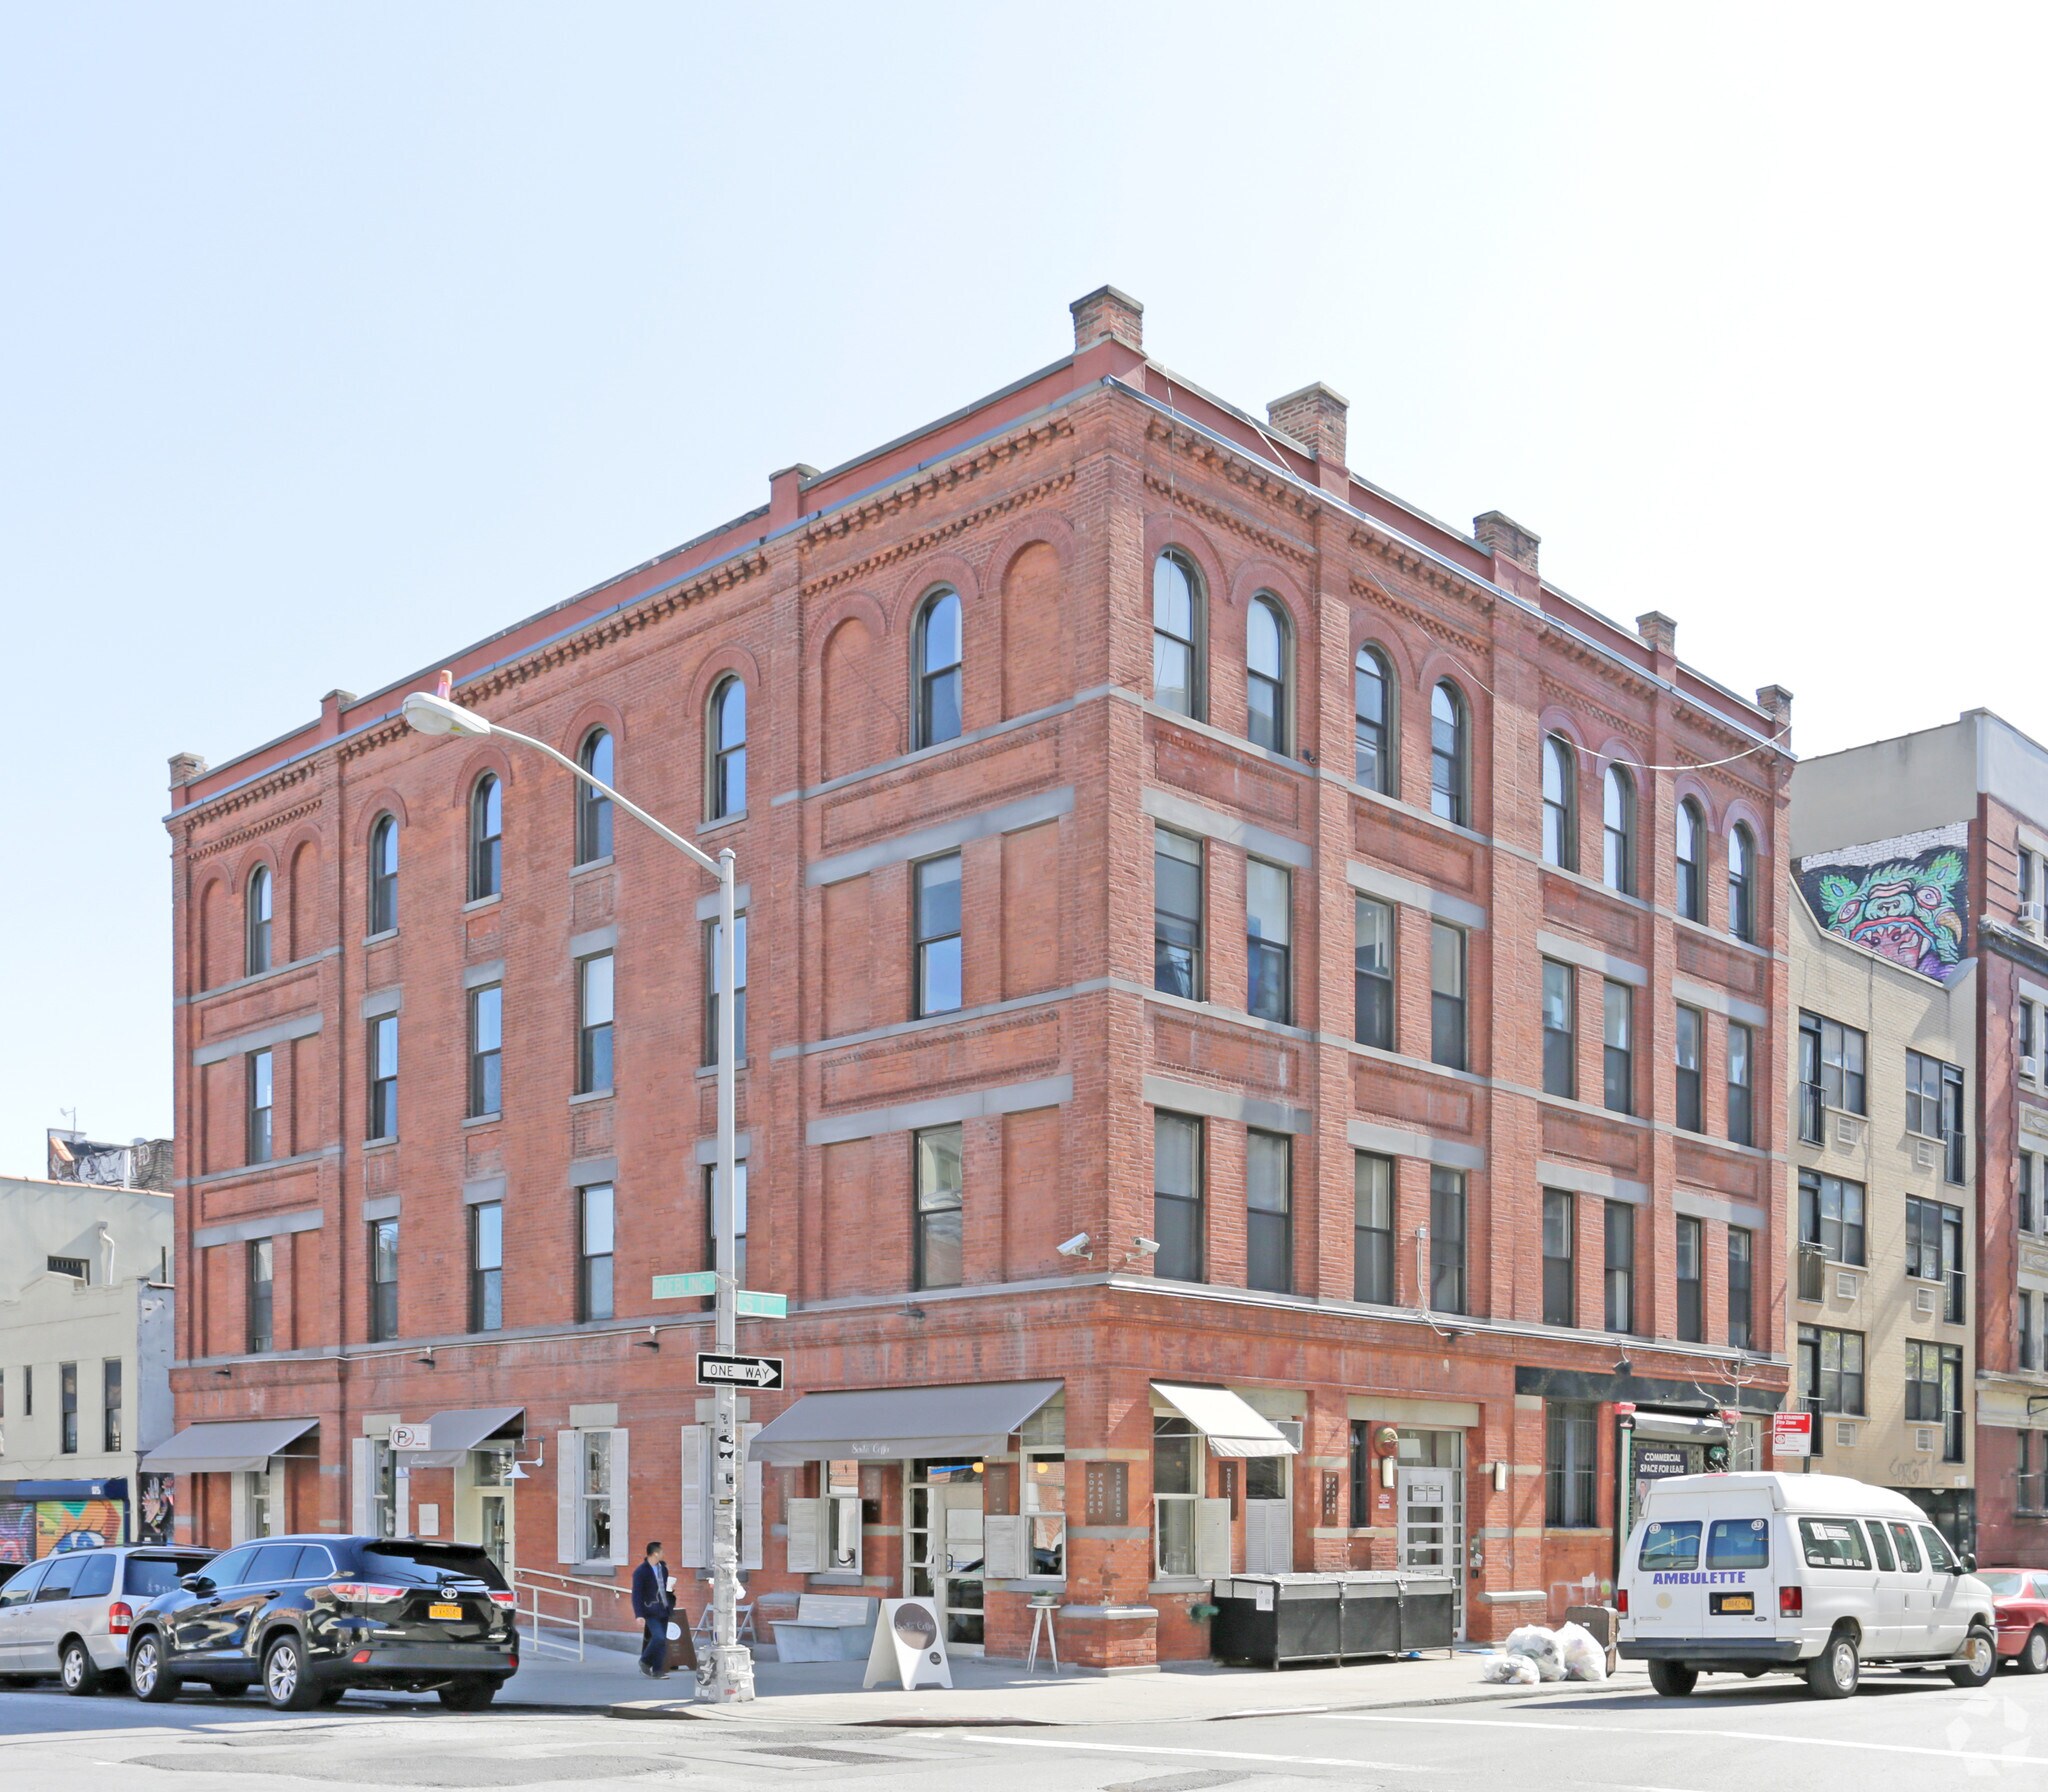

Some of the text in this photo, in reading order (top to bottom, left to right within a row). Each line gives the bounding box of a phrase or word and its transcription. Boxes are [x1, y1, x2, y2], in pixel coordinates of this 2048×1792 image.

[654, 1276, 704, 1294] ROEBLING
[743, 1295, 753, 1312] S
[710, 1364, 770, 1379] ONE WAY
[1644, 1452, 1681, 1462] COMMERCIAL
[1639, 1464, 1685, 1474] SPACE FOR LEASE
[1653, 1571, 1746, 1585] AMBULETTE
